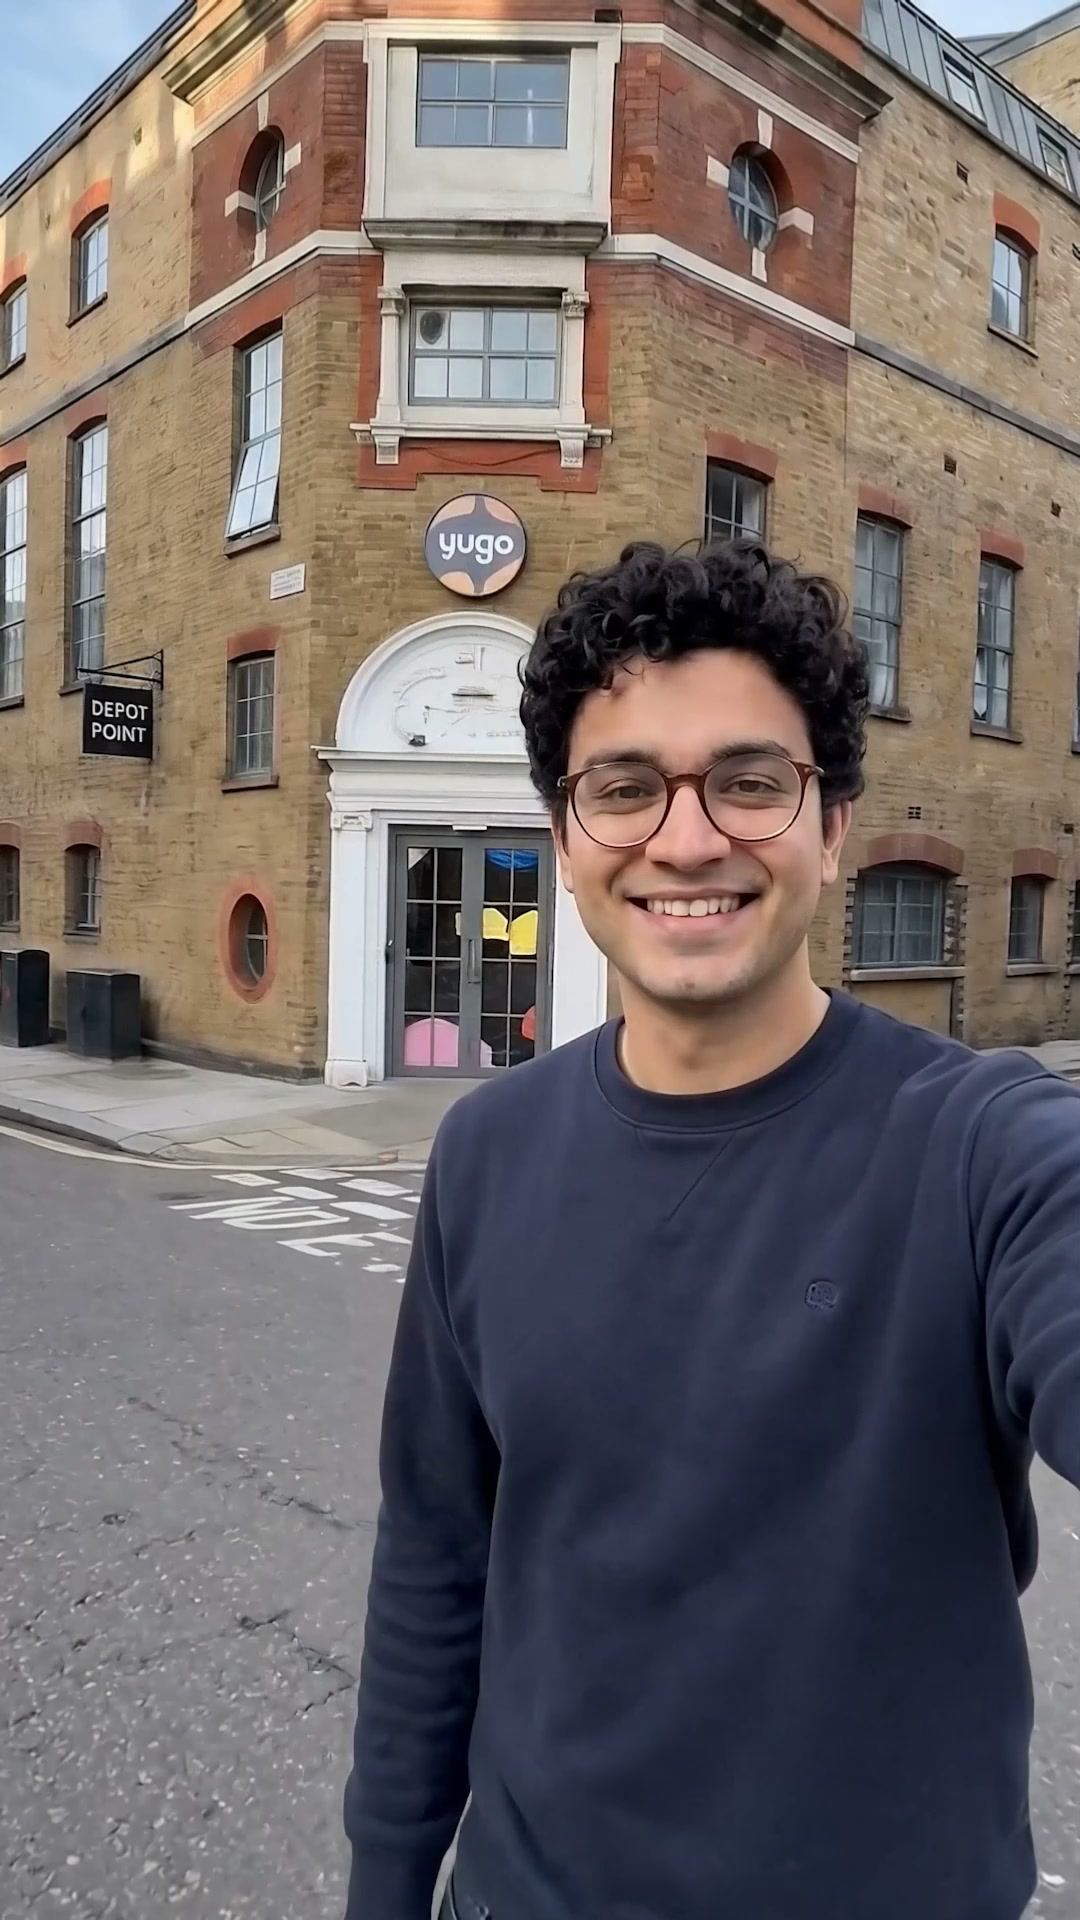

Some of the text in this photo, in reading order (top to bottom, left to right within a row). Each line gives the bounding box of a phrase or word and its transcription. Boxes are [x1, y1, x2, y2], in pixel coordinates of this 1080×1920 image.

[439, 532, 514, 565] yugo
[91, 698, 149, 721] DEPOT
[91, 721, 147, 743] POINT
